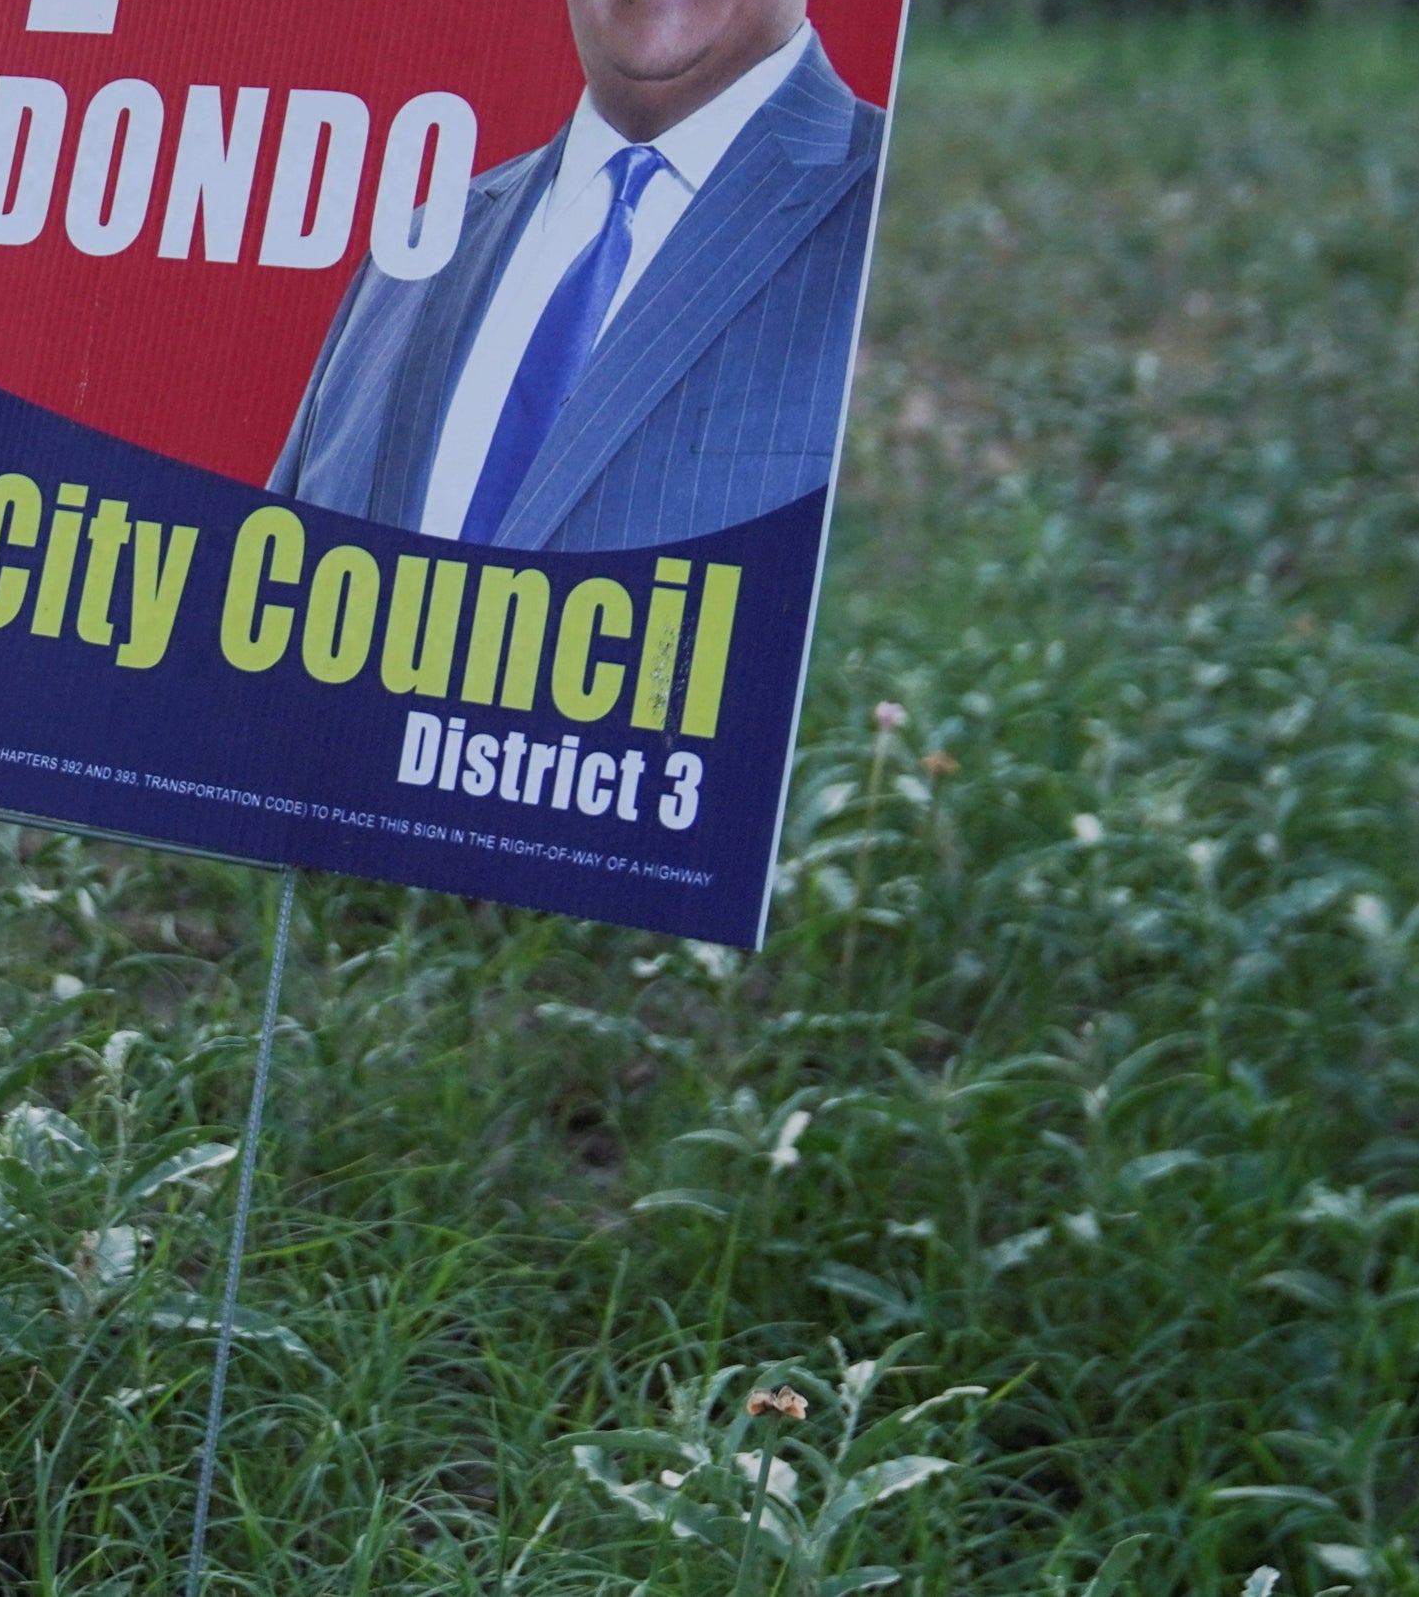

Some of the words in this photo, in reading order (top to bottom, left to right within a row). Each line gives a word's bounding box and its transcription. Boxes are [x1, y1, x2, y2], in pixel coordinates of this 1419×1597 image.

[220, 505, 743, 740] Council
[61, 759, 83, 774] 392
[84, 764, 112, 780] AND
[144, 774, 261, 807] TRANSPORTATION
[265, 796, 308, 817] CODE)
[311, 804, 330, 819] TO
[331, 808, 375, 828] PLACE
[379, 816, 409, 834] THIS
[412, 822, 447, 840] SIGN
[449, 830, 463, 843] IN
[469, 832, 495, 850] THE
[499, 837, 603, 867] RIGHT-OF-WAY
[606, 856, 628, 871] OF
[628, 861, 640, 875] A
[643, 863, 713, 887] HIGHWAY
[397, 710, 646, 823] District
[658, 751, 703, 830] 3
